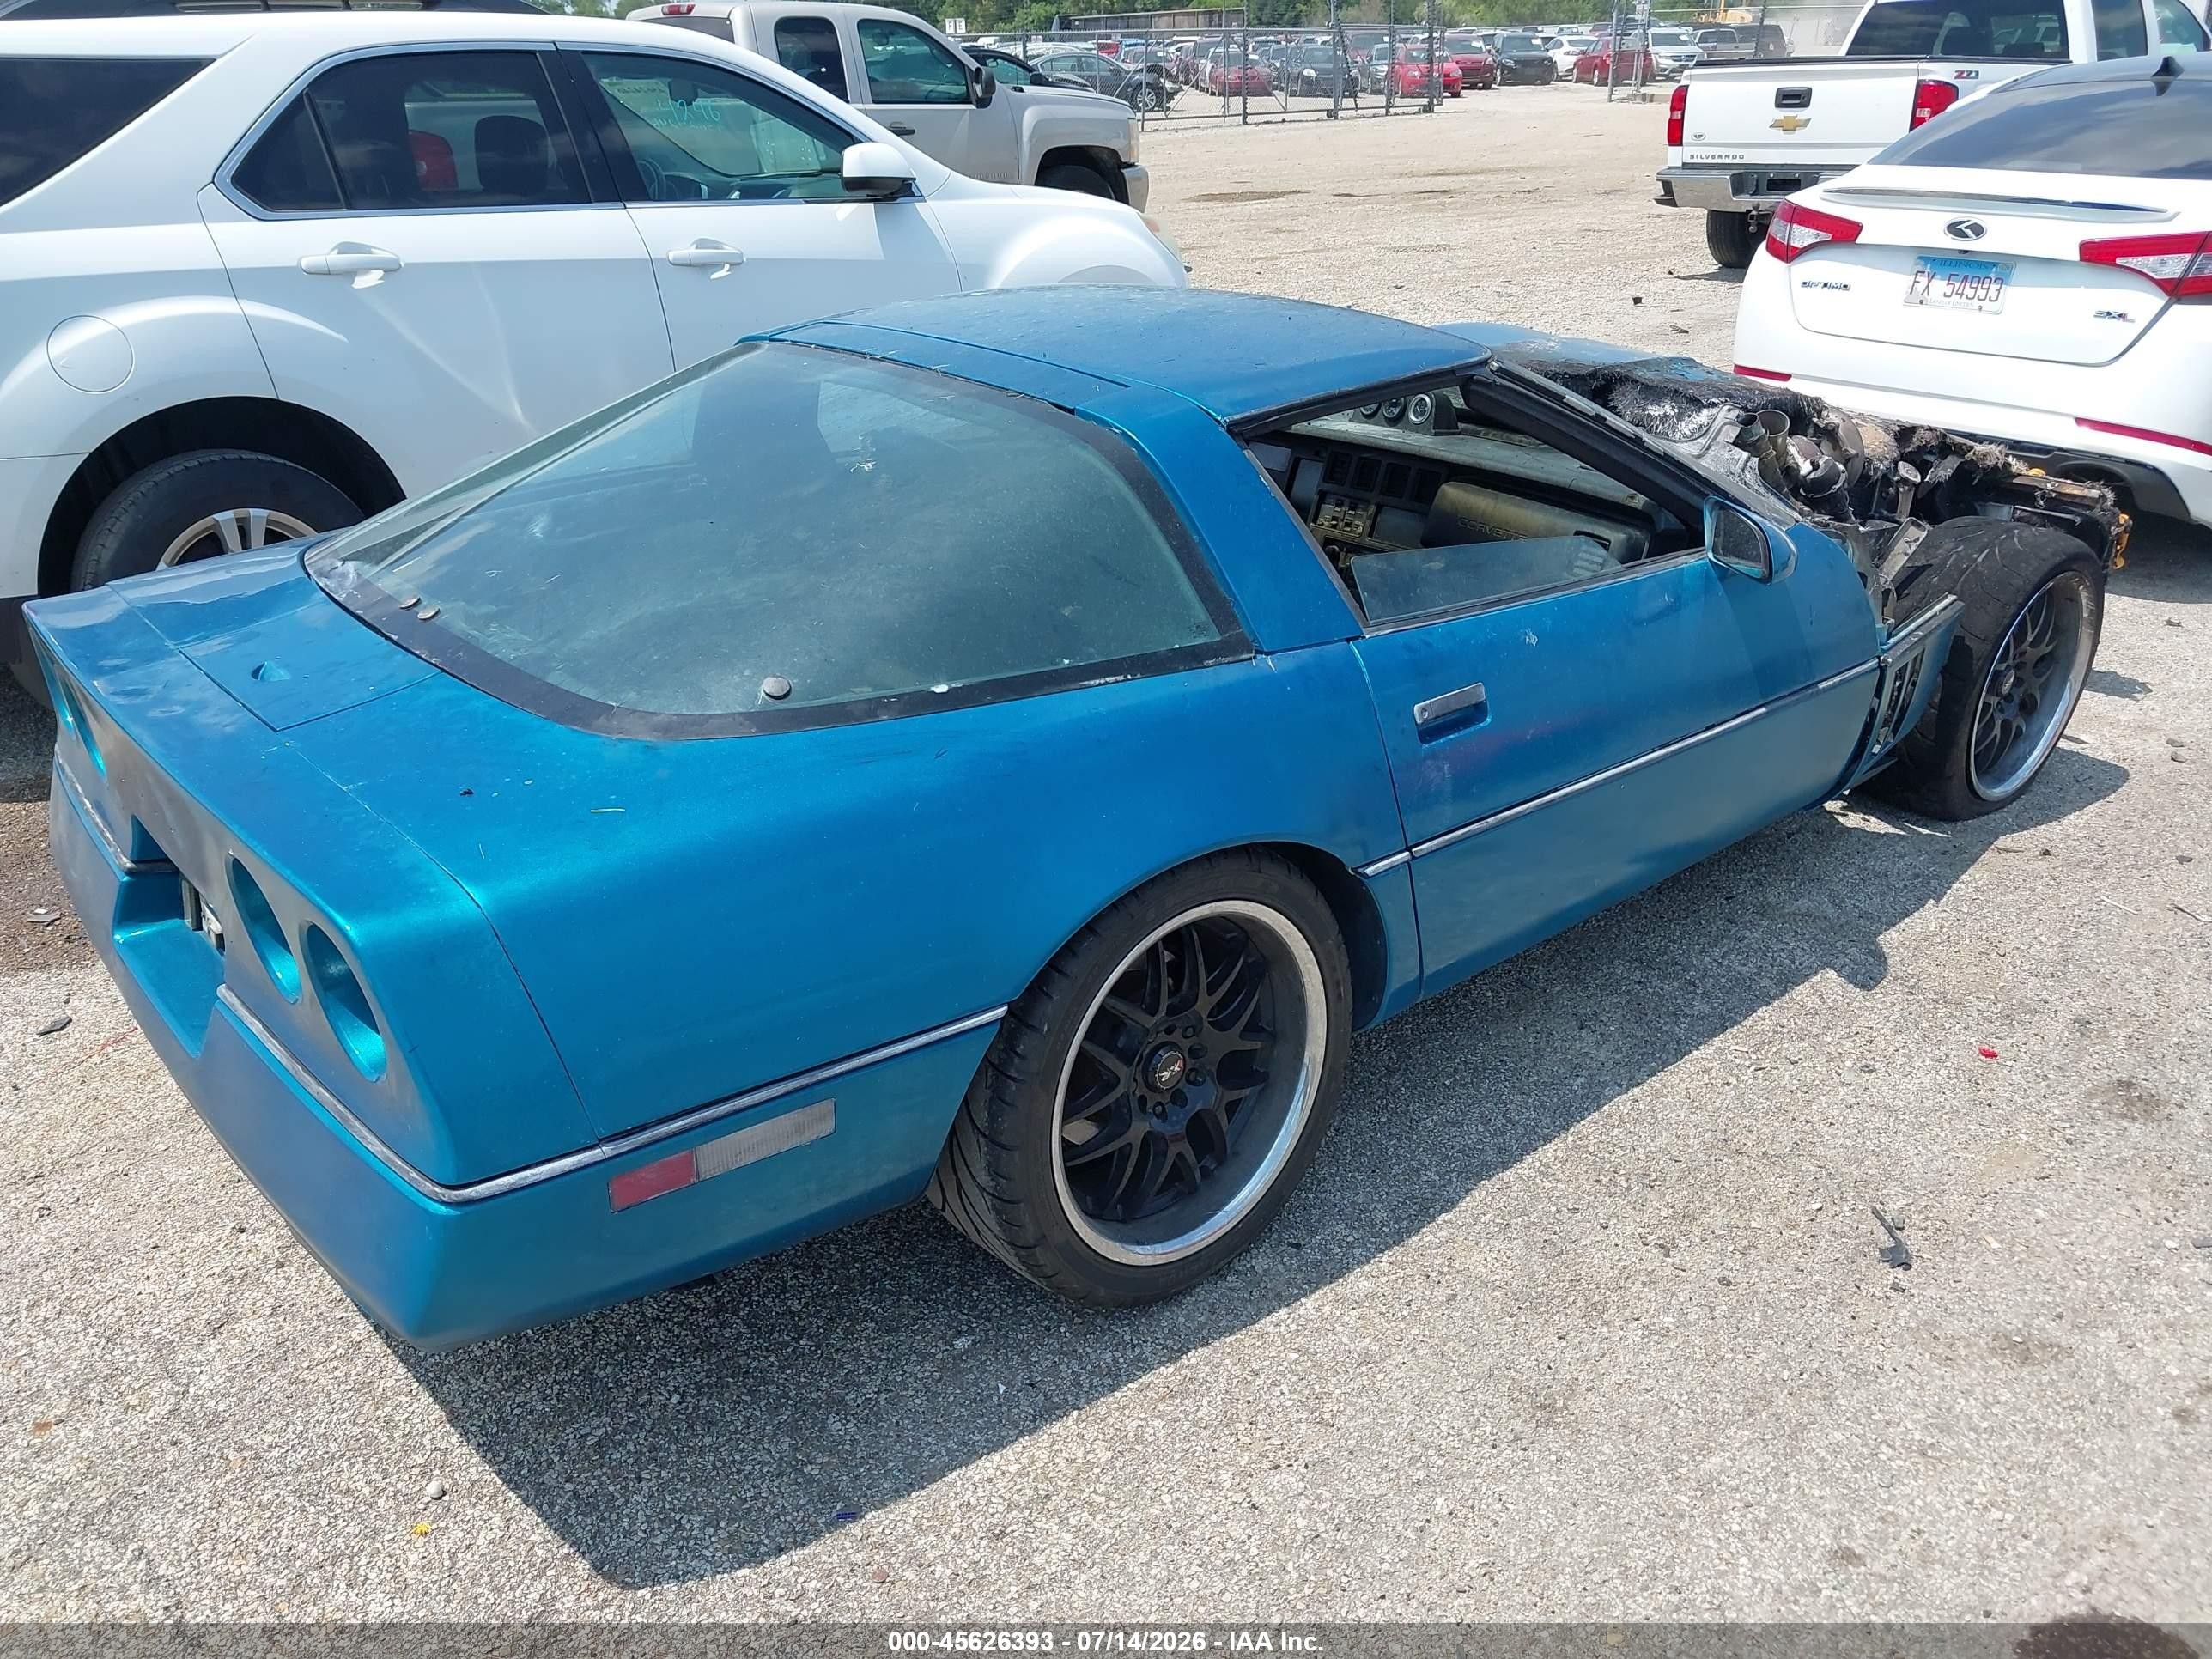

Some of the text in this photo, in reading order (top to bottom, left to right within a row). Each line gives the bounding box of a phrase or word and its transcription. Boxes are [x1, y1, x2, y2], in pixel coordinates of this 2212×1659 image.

[1939, 259, 1990, 270] ILLINOIS
[1910, 270, 2004, 302] FX 54993
[1458, 516, 1528, 543] CORVETTE
